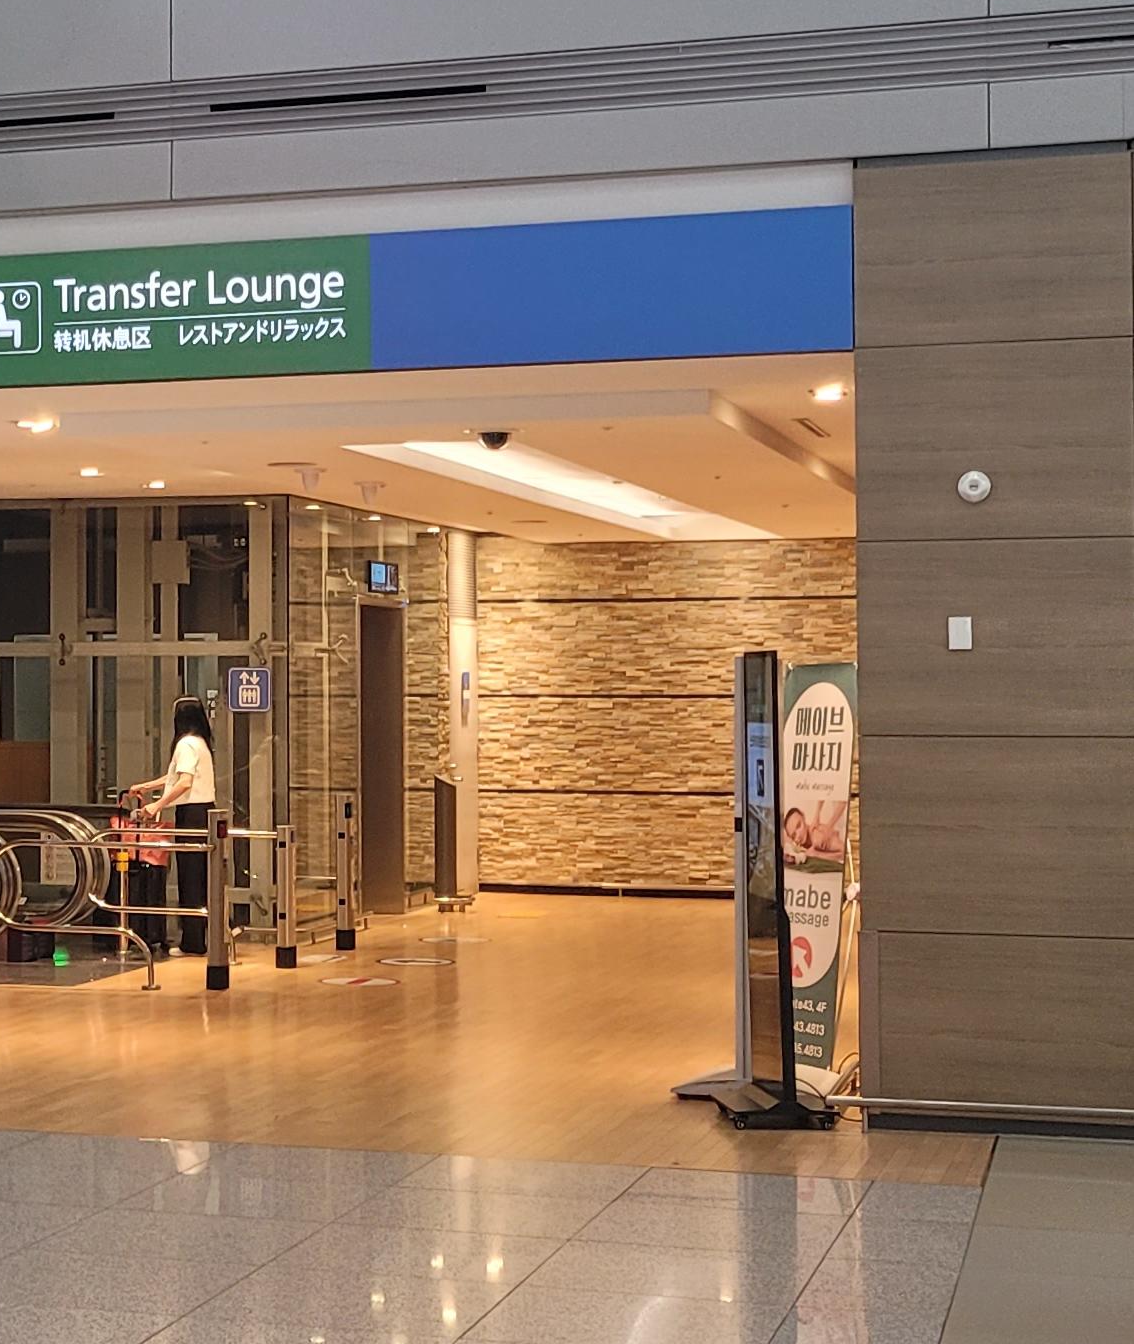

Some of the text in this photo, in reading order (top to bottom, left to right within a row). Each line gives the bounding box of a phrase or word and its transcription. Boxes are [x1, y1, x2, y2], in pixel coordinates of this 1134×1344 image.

[53, 269, 345, 313] Transfer Lounge
[179, 317, 347, 347] レストアンドリラックス
[795, 706, 845, 736] 메이브
[792, 742, 842, 772] 마사지
[788, 911, 829, 928] assage
